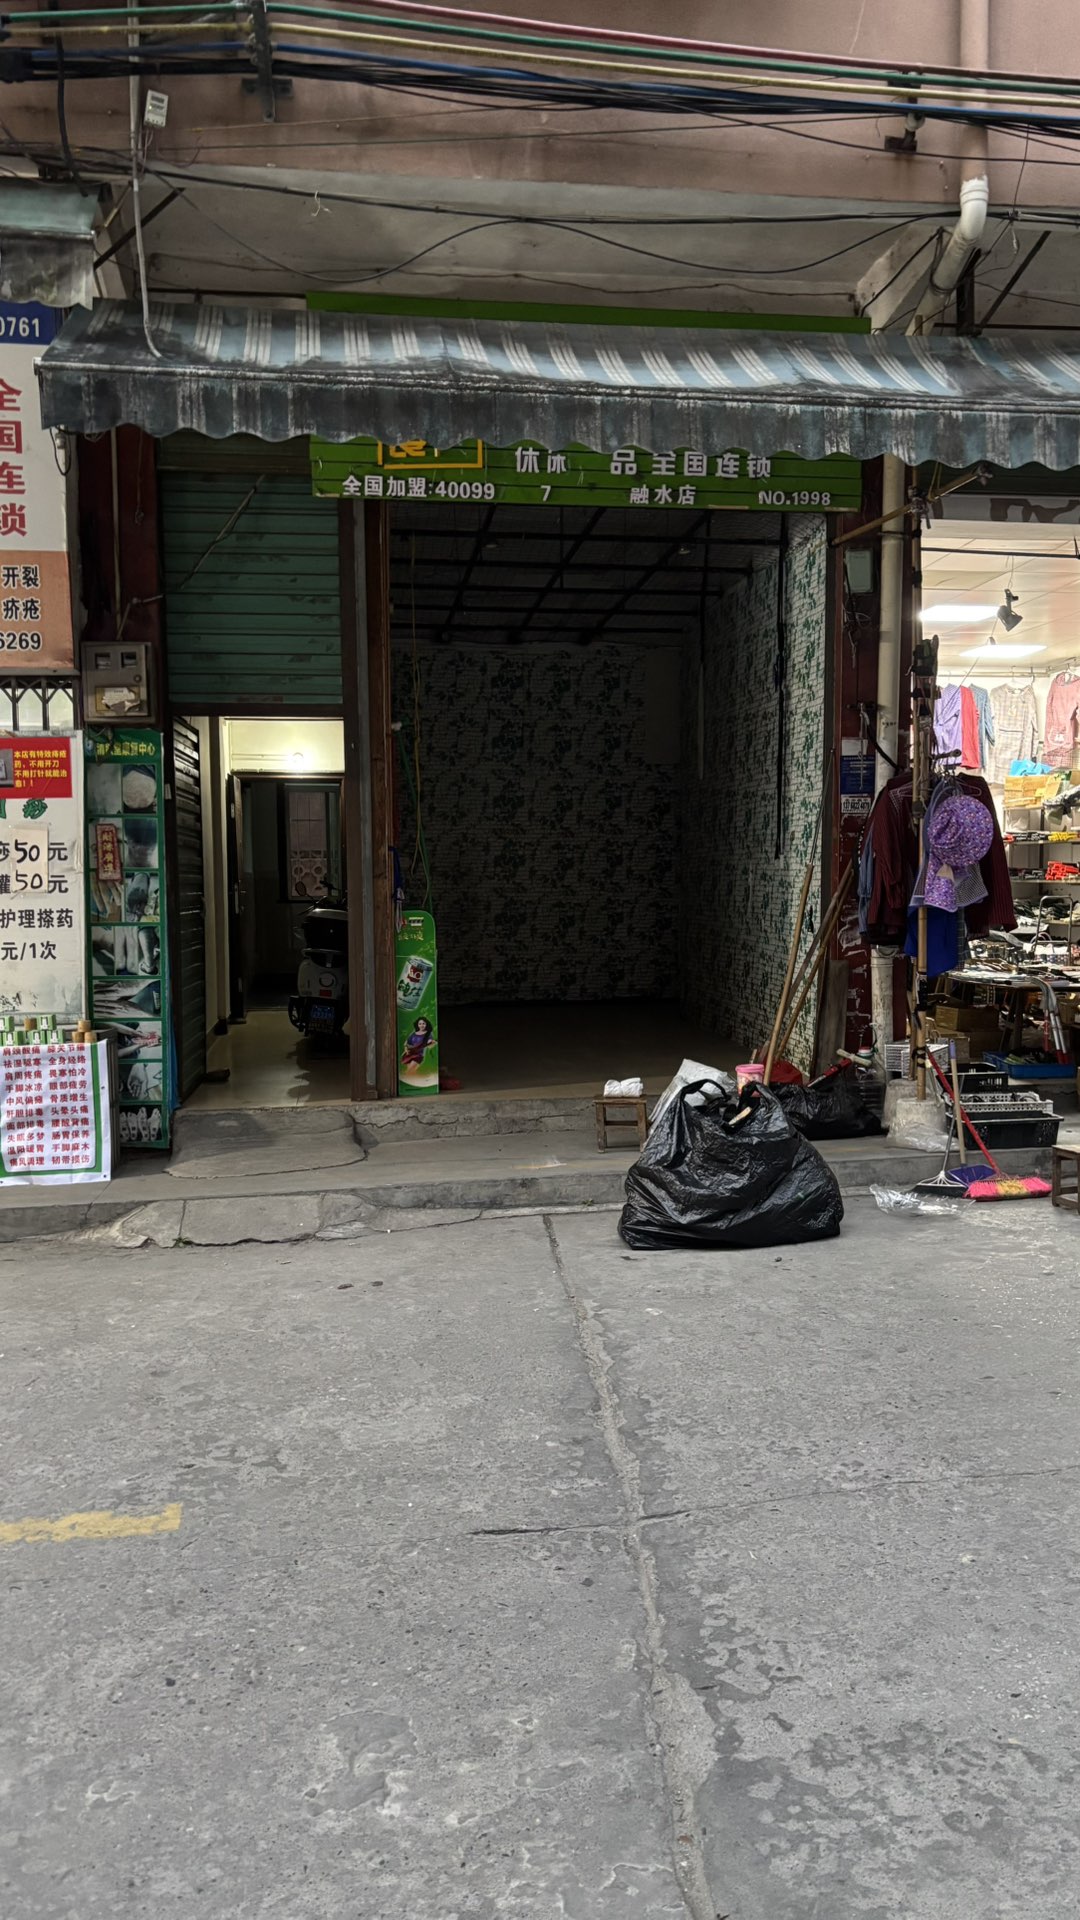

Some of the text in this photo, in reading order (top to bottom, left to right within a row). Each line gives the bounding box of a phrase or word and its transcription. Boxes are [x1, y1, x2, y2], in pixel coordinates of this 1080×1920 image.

[629, 483, 696, 505] 融水店
[758, 490, 831, 506] NO.1998
[2, 565, 40, 588] 开裂
[3, 597, 40, 620] 疥疮
[49, 1055, 86, 1066] 全身经络
[49, 1067, 87, 1078] 畏寒怕冷
[50, 1093, 88, 1103] 骨质增生
[6, 1108, 44, 1118] 肝胆排毒
[7, 1132, 45, 1143] 失眠多梦
